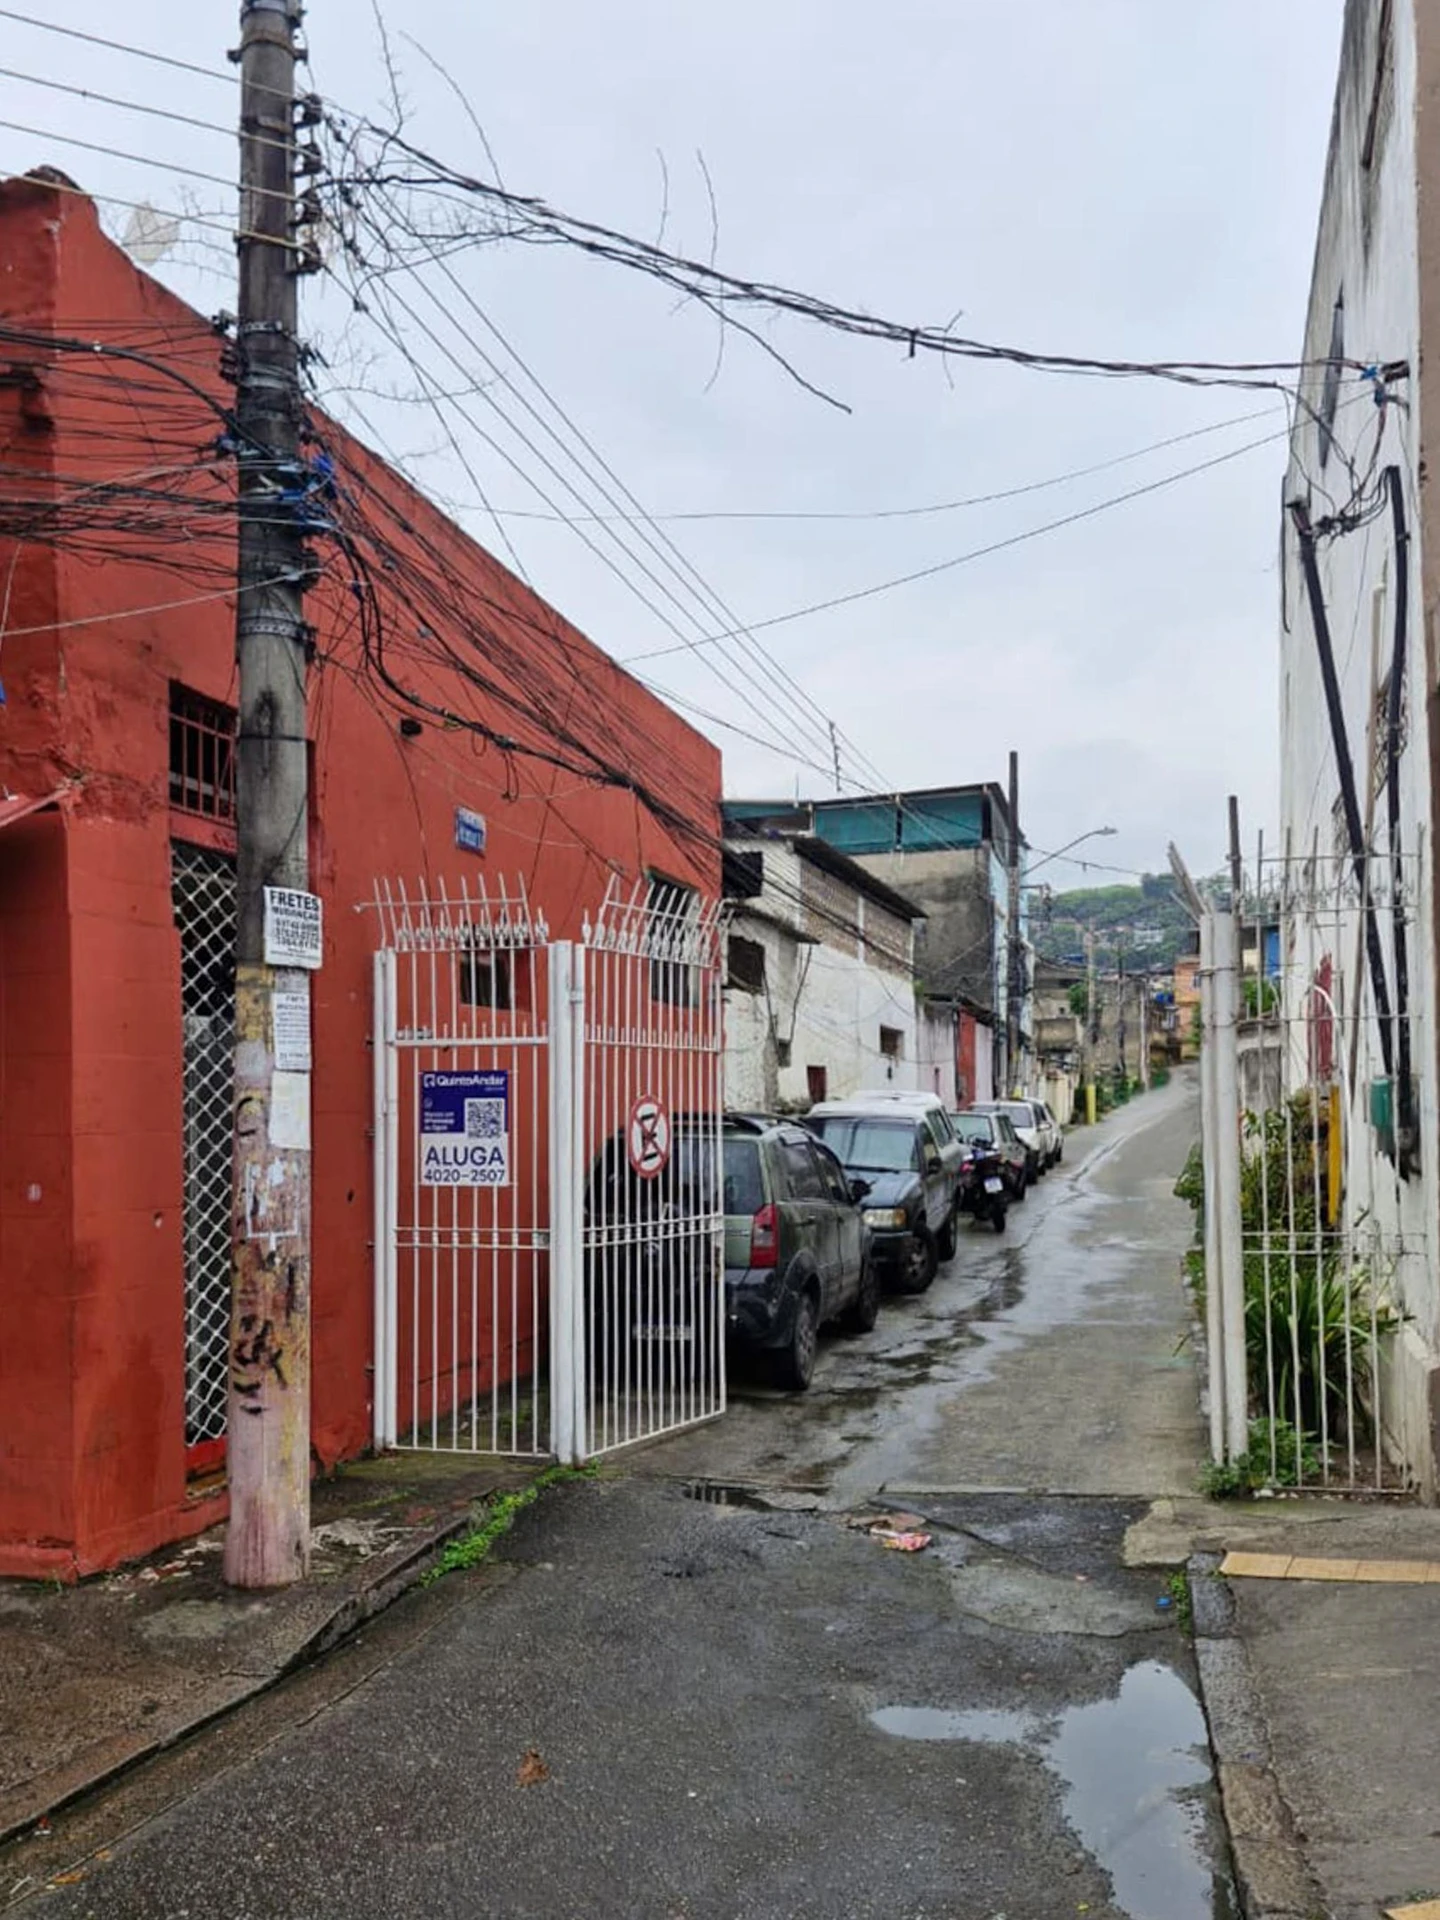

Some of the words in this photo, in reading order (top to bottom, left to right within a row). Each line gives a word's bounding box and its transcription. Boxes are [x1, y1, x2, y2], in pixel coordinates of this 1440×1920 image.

[270, 889, 319, 911] FRETES
[437, 1074, 505, 1087] QuintoAndar
[425, 1145, 505, 1166] ALUGA
[424, 1168, 505, 1182] 4020-2507
